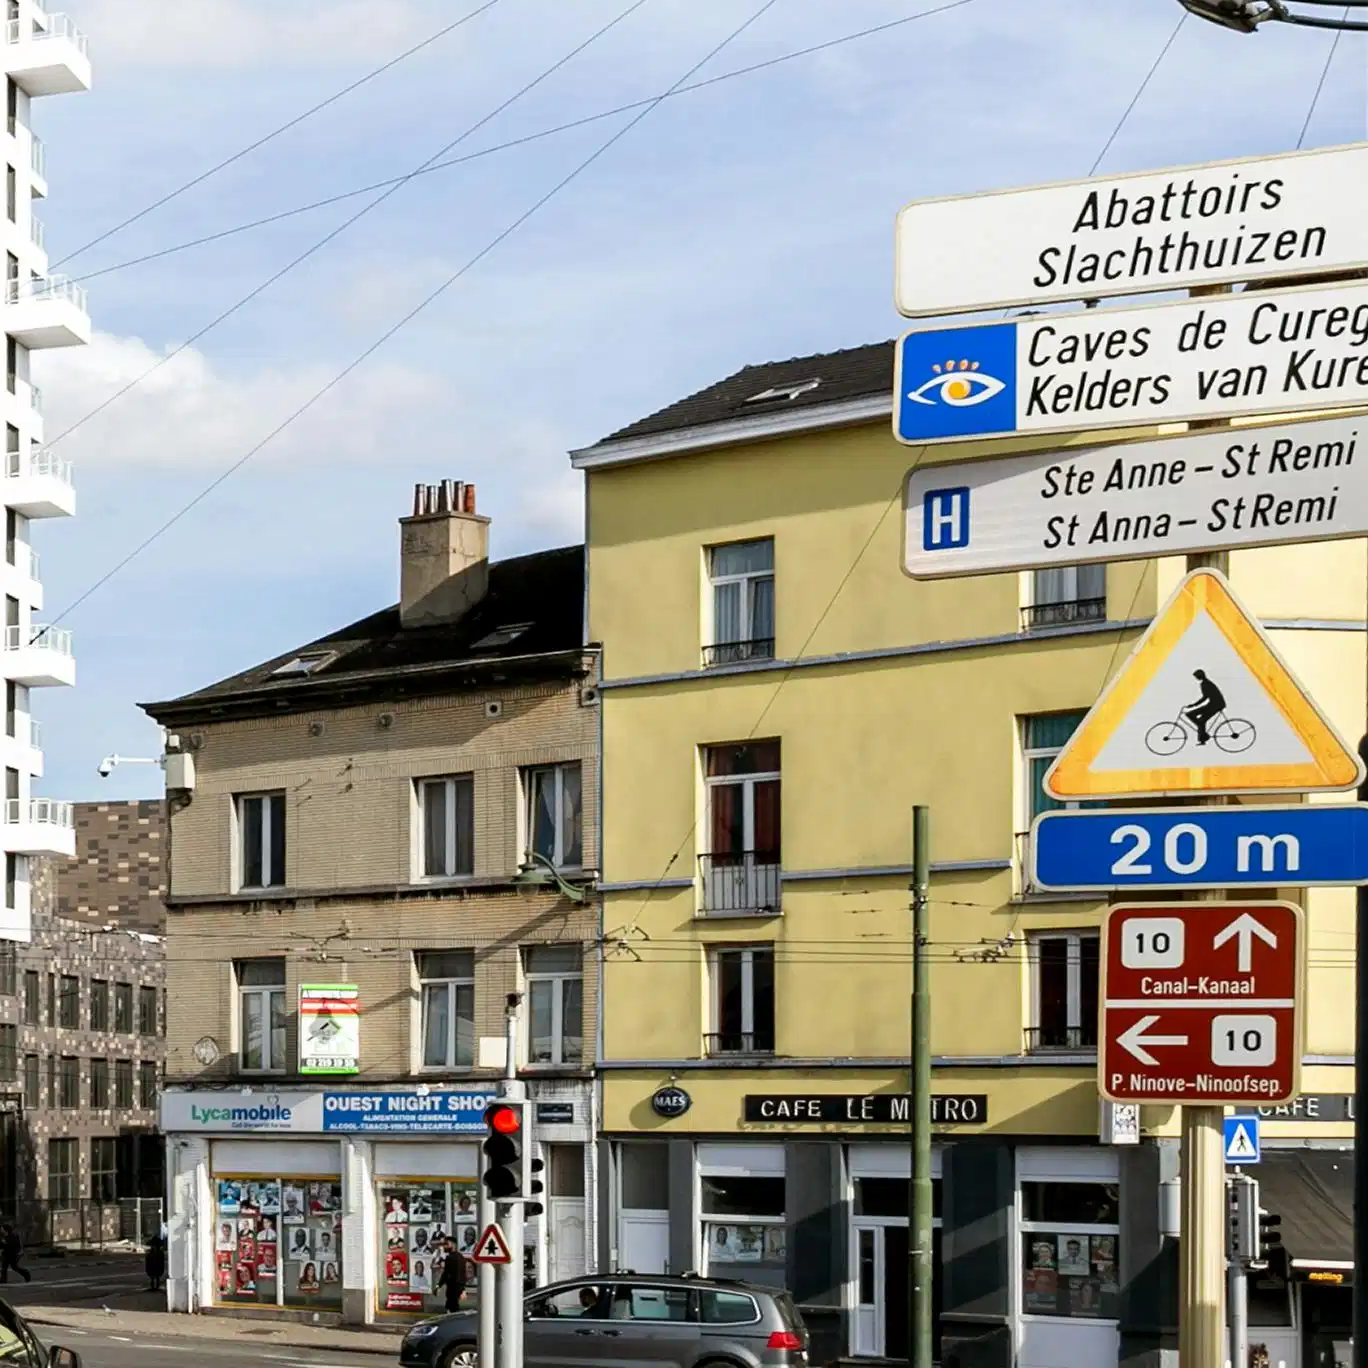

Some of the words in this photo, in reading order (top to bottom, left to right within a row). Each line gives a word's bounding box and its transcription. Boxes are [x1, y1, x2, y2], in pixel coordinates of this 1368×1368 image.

[1072, 174, 1285, 232] Abattoirs
[1033, 225, 1327, 287] Slachthuizen
[1028, 324, 1152, 367] Caves
[1178, 310, 1226, 351] de
[1026, 370, 1171, 416] Kelders
[1198, 364, 1267, 400] van
[1041, 465, 1094, 499] Ste
[1103, 458, 1185, 493] Anne
[1221, 442, 1261, 479] St
[1269, 431, 1357, 475] Remi
[1043, 515, 1079, 550] St
[1089, 512, 1169, 546] Anna
[1207, 497, 1243, 532] St
[1250, 486, 1339, 528] Remi
[1110, 822, 1208, 875] 20
[1237, 834, 1300, 872] m
[1136, 932, 1171, 954] 10
[1226, 1030, 1262, 1052] 10
[655, 1095, 687, 1107] MAES
[1112, 1074, 1126, 1091] P.
[191, 1104, 292, 1124] Lycamobile
[325, 1096, 383, 1111] OUEST
[388, 1096, 443, 1111] NIGHT
[760, 1099, 822, 1117] CAFE
[847, 1096, 875, 1120] LE
[890, 1097, 978, 1120] MTRO
